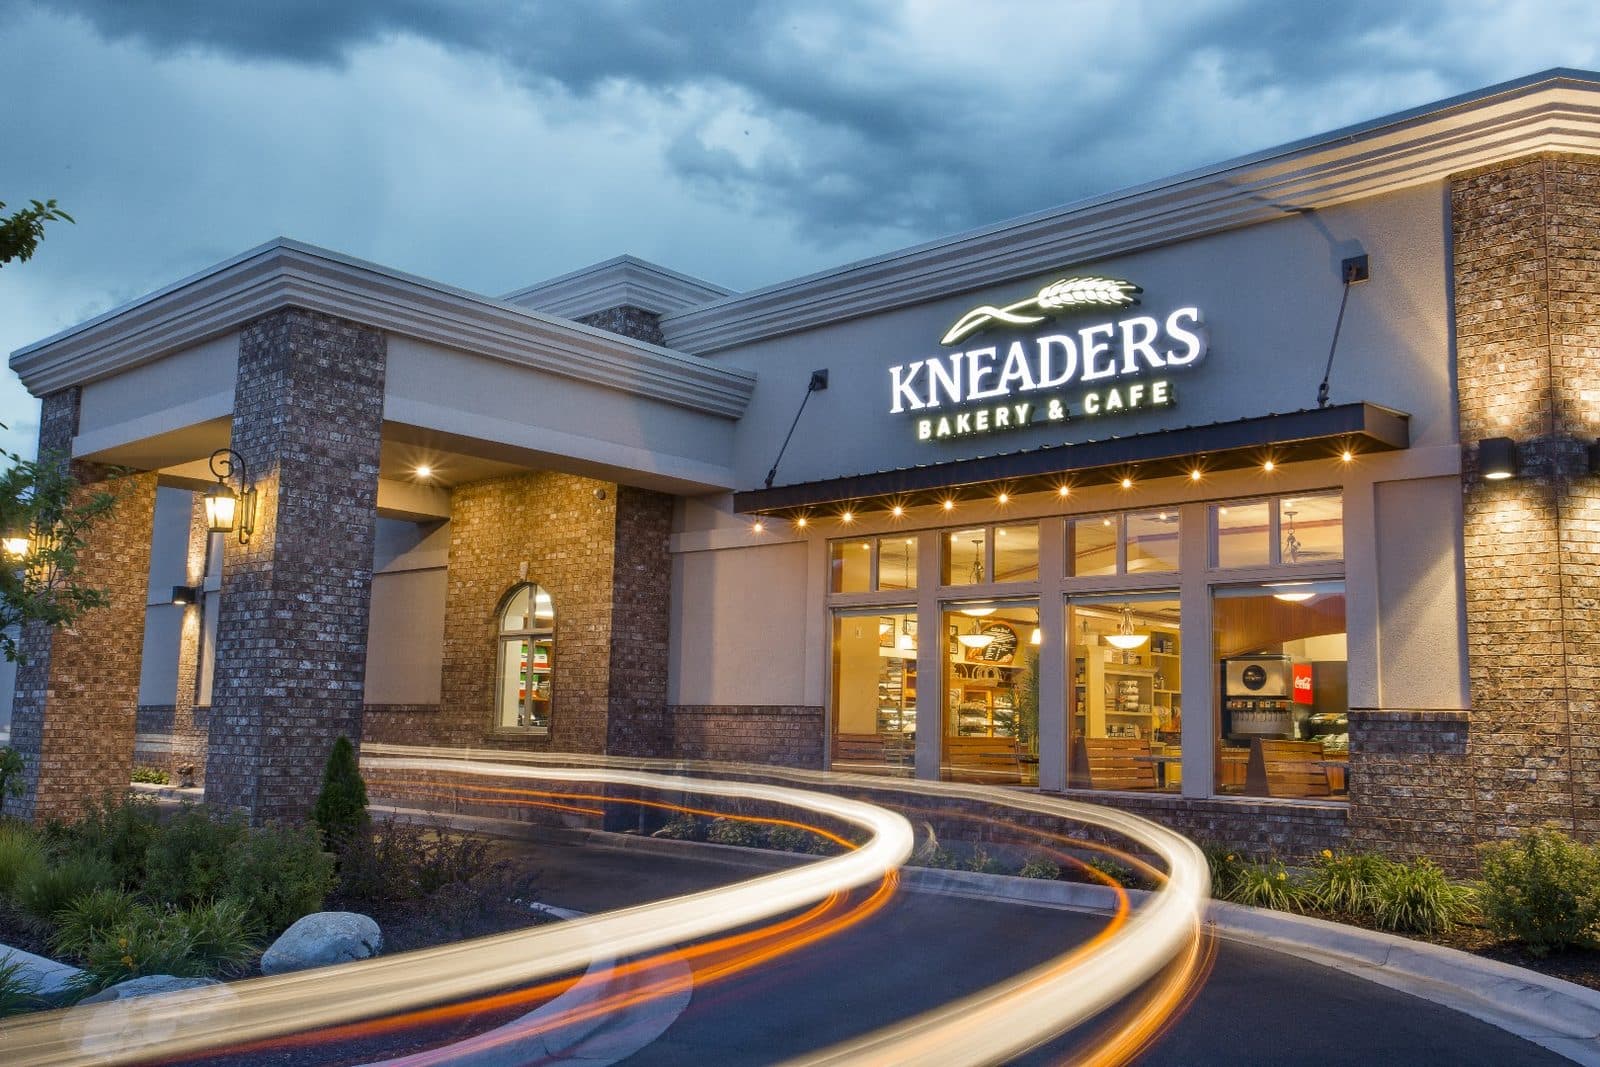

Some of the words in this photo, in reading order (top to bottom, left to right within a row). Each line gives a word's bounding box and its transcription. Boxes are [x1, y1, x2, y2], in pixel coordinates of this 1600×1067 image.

[889, 307, 1202, 414] KNEADERS
[918, 403, 1030, 440] BAKERY
[1049, 400, 1065, 421] &
[1084, 381, 1169, 414] CAFE
